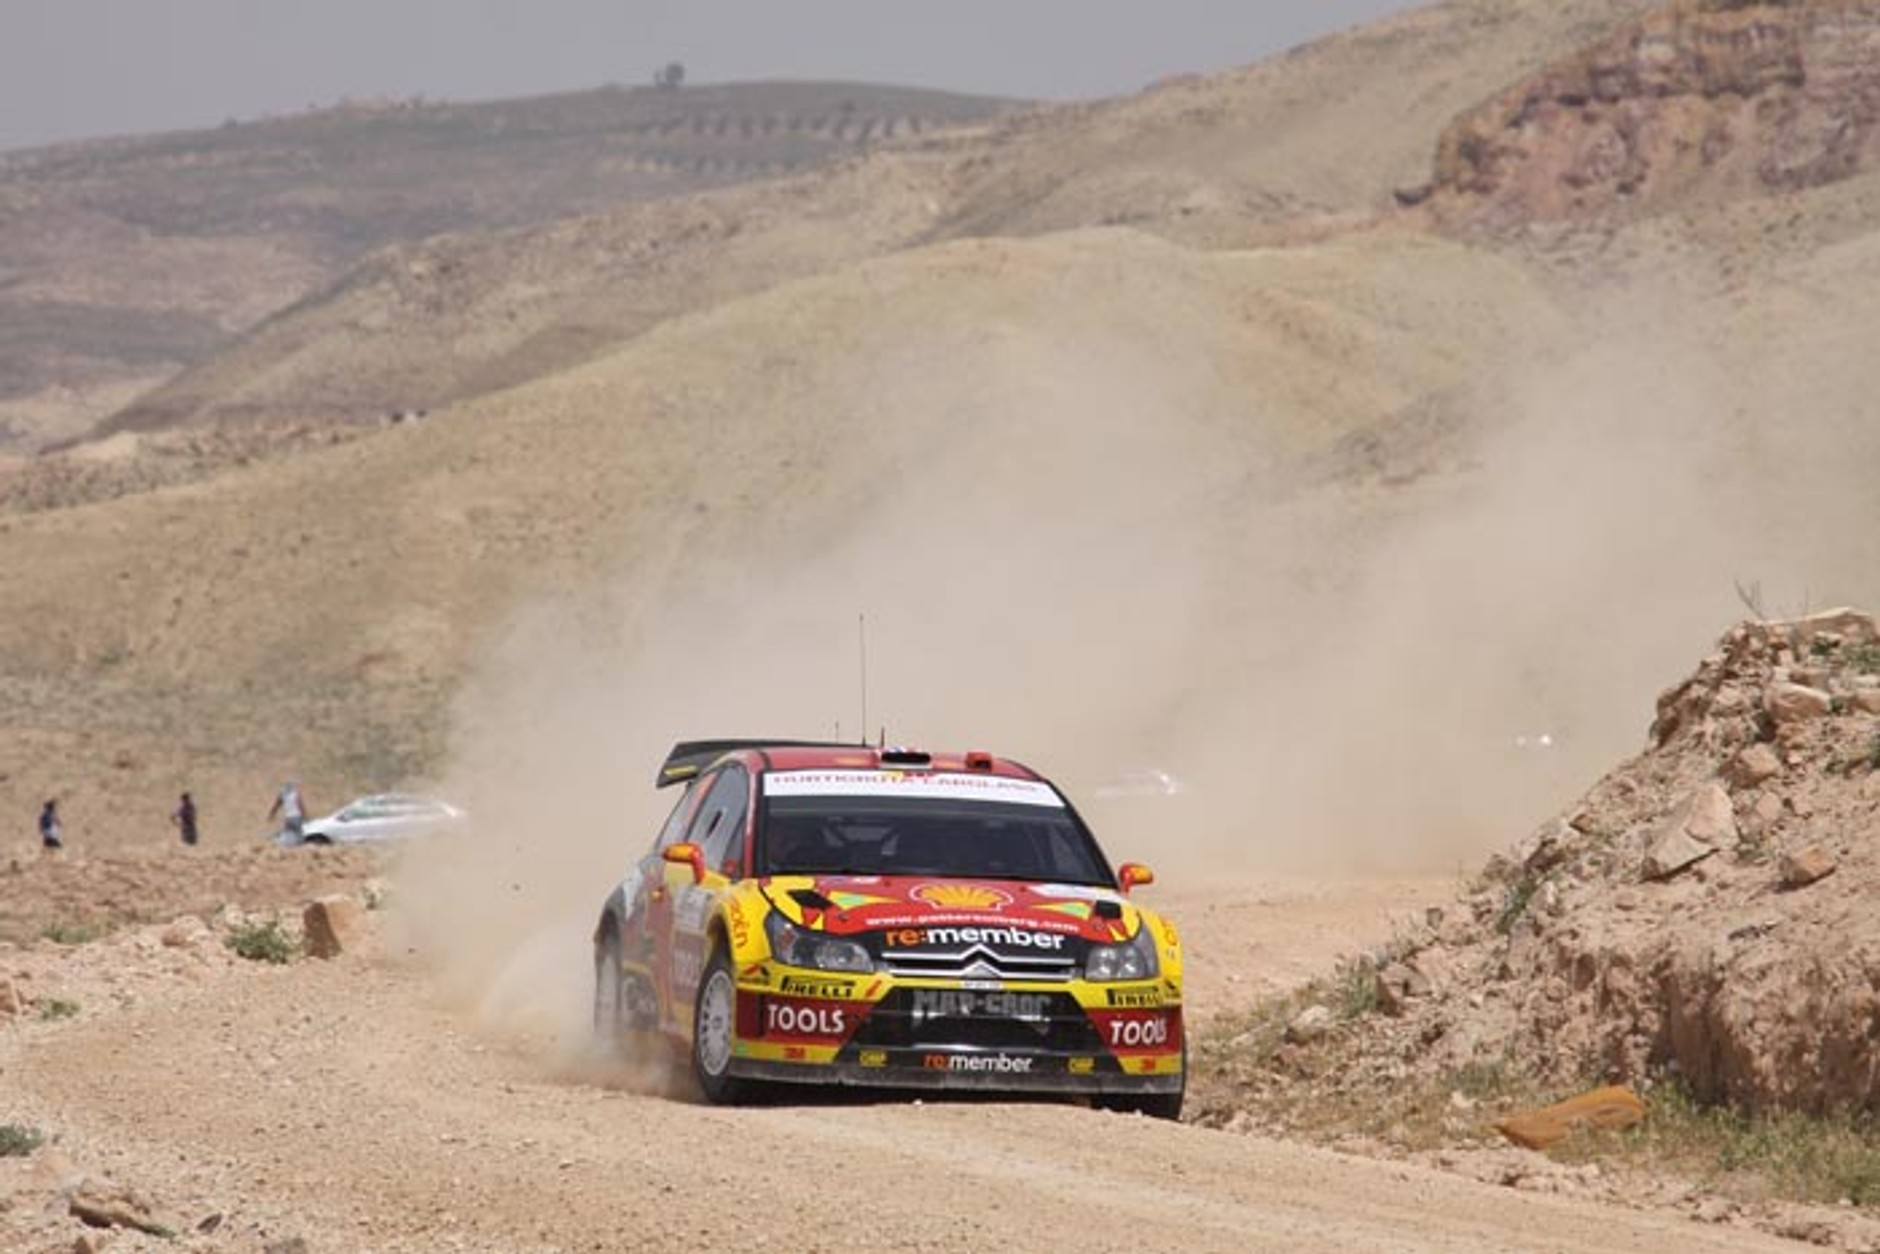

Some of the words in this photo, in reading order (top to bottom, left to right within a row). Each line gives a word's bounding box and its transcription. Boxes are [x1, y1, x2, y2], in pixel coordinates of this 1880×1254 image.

[886, 926, 1066, 950] re:member
[781, 975, 856, 997] PIRELLI
[768, 1003, 845, 1033] TOOLS
[1110, 1018, 1166, 1045] TOOLS
[924, 1052, 1032, 1073] re:member
